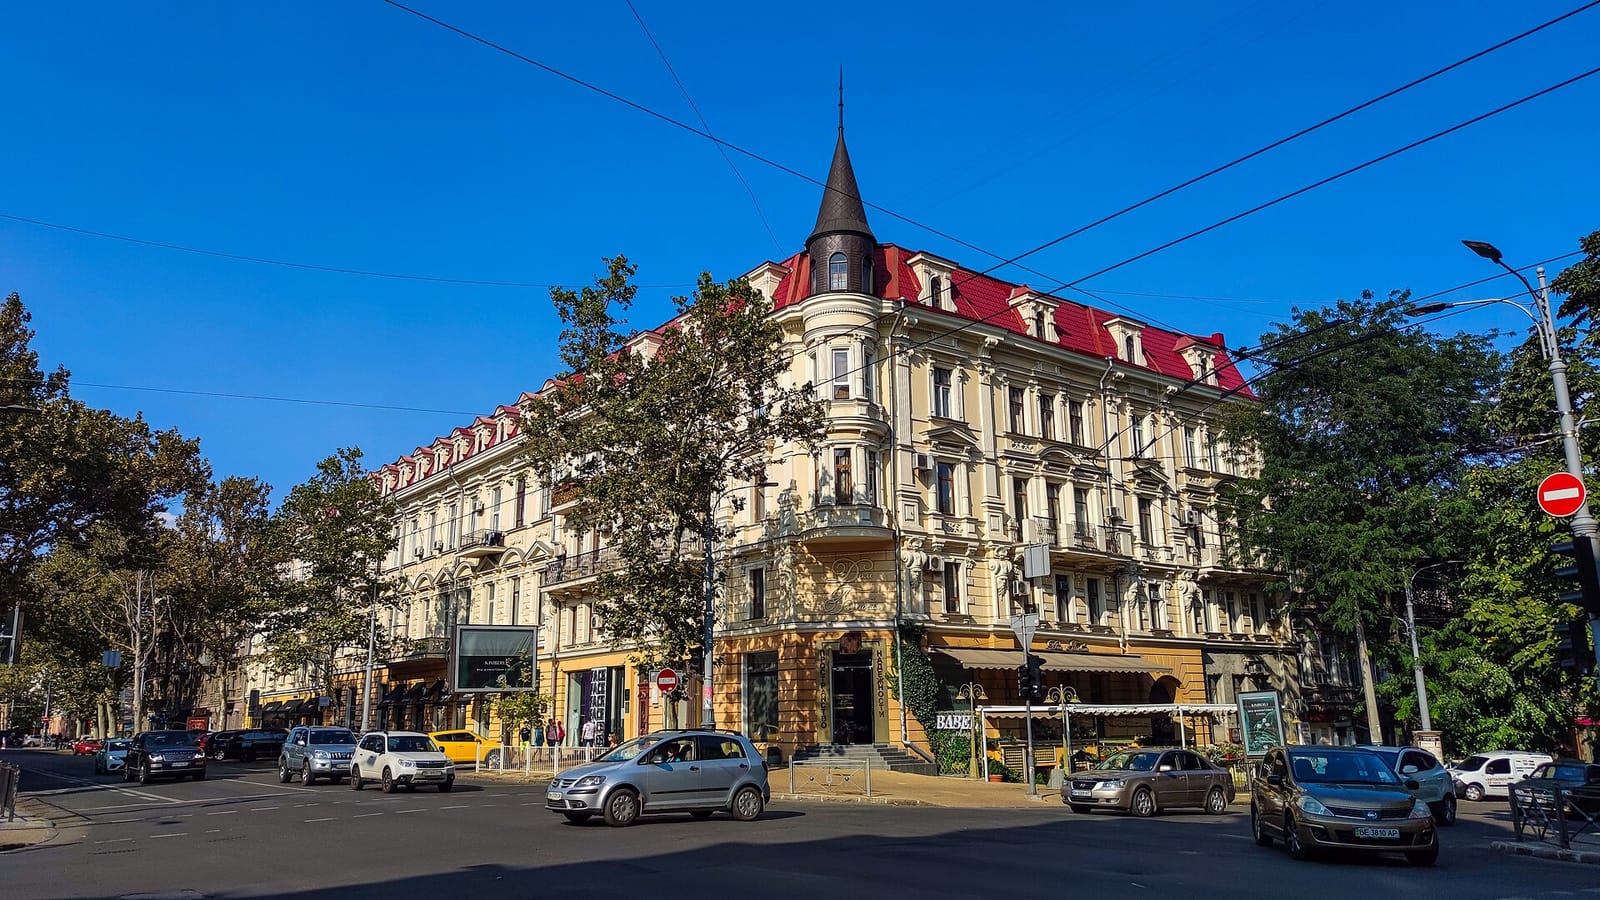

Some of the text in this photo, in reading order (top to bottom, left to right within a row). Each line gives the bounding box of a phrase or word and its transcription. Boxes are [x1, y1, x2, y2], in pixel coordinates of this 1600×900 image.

[819, 650, 827, 729] ПРОСТРАНСТВО
[876, 650, 885, 718] НАДЕЖНОСТИ
[1360, 828, 1369, 836] BE
[1370, 829, 1386, 837] 3810
